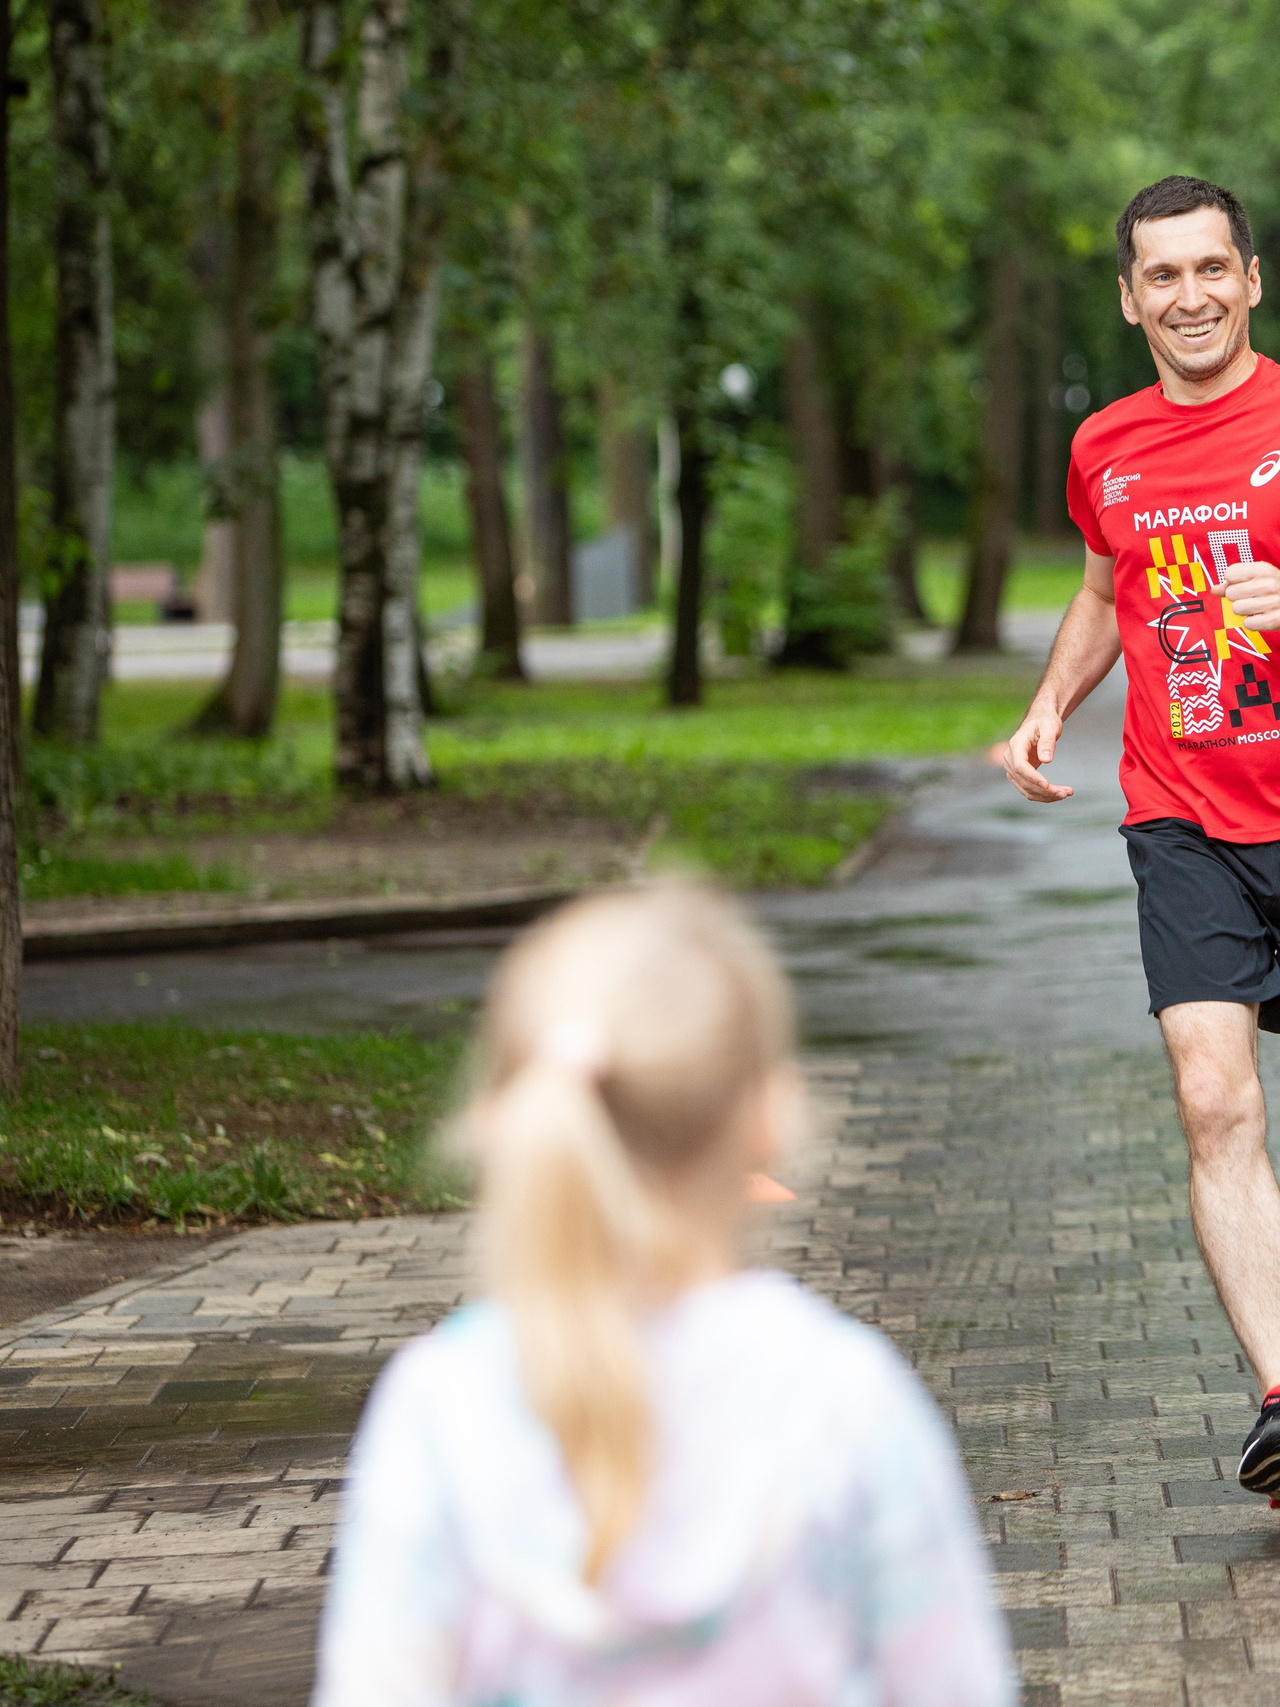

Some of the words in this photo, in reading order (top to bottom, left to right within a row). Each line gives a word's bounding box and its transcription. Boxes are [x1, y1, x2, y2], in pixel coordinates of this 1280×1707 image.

[1133, 501, 1247, 532] МАРАФОН
[1171, 703, 1182, 737] 2022
[1178, 737, 1236, 751] MARATHON
